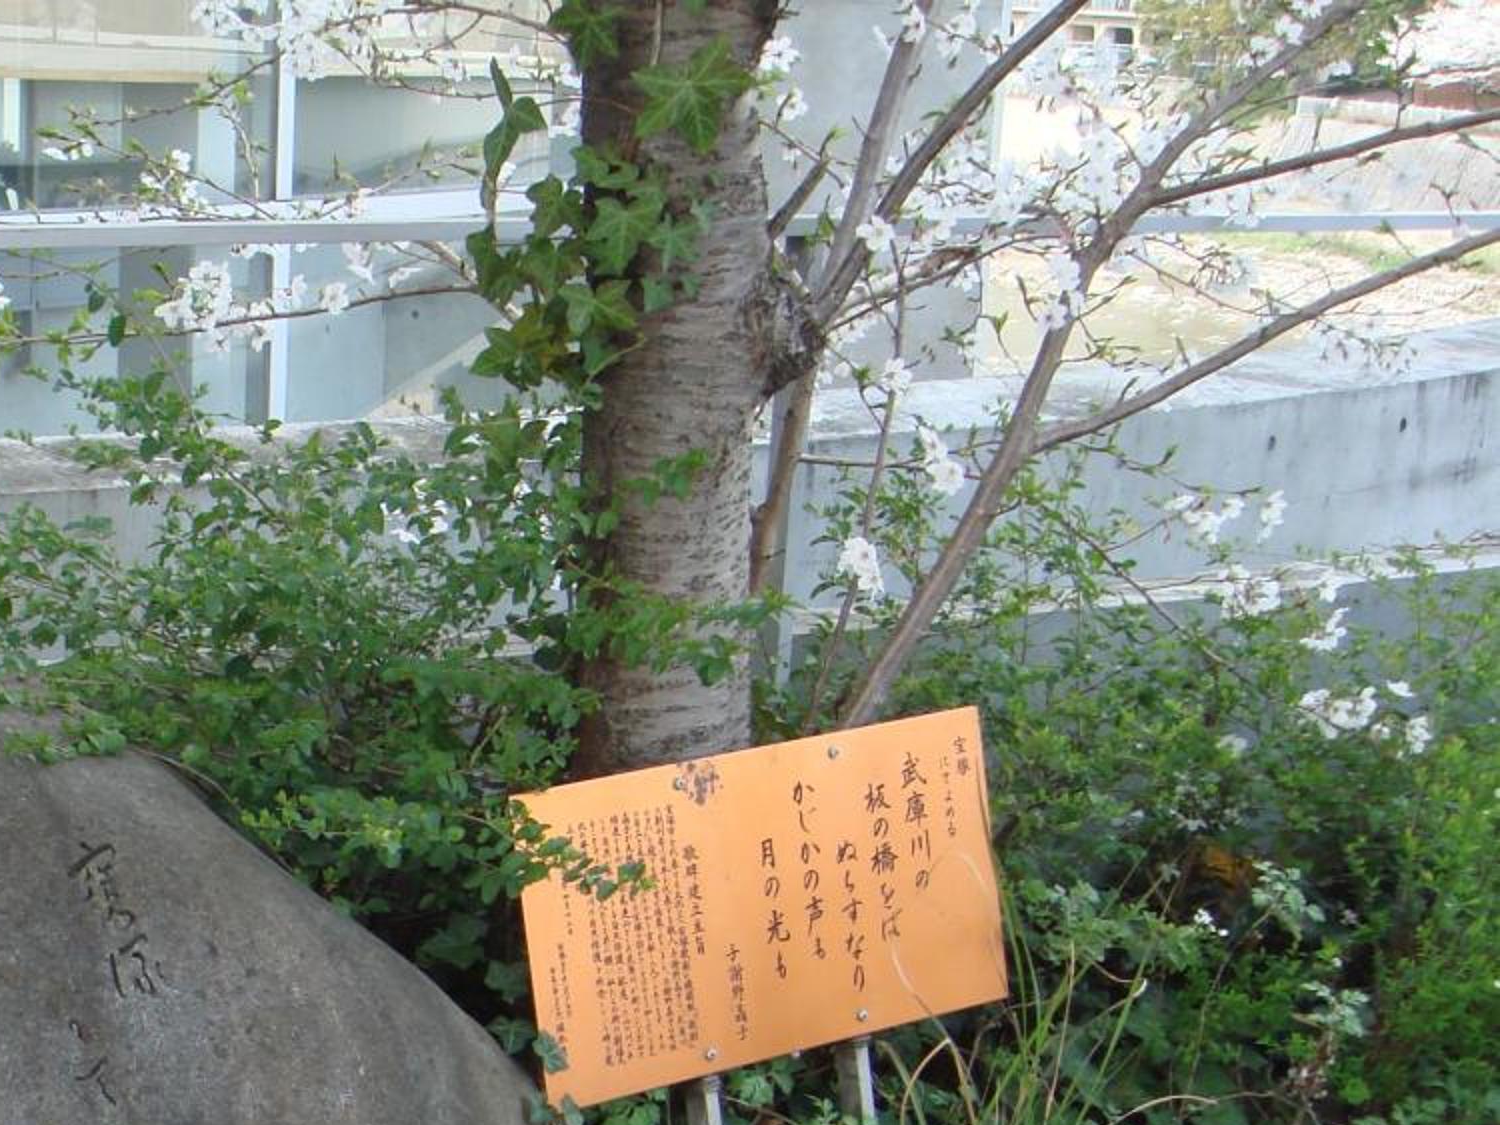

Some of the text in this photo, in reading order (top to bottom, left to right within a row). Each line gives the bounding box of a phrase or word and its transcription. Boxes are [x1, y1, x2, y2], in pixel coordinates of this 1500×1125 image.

[792, 782, 827, 960] かじかの声も
[864, 783, 902, 942] 板の橋をば
[901, 752, 931, 891] 武庫川の
[761, 838, 791, 981] 月の光も
[836, 840, 866, 993] ぬらすなり
[725, 943, 749, 1041] 与謝野晶子
